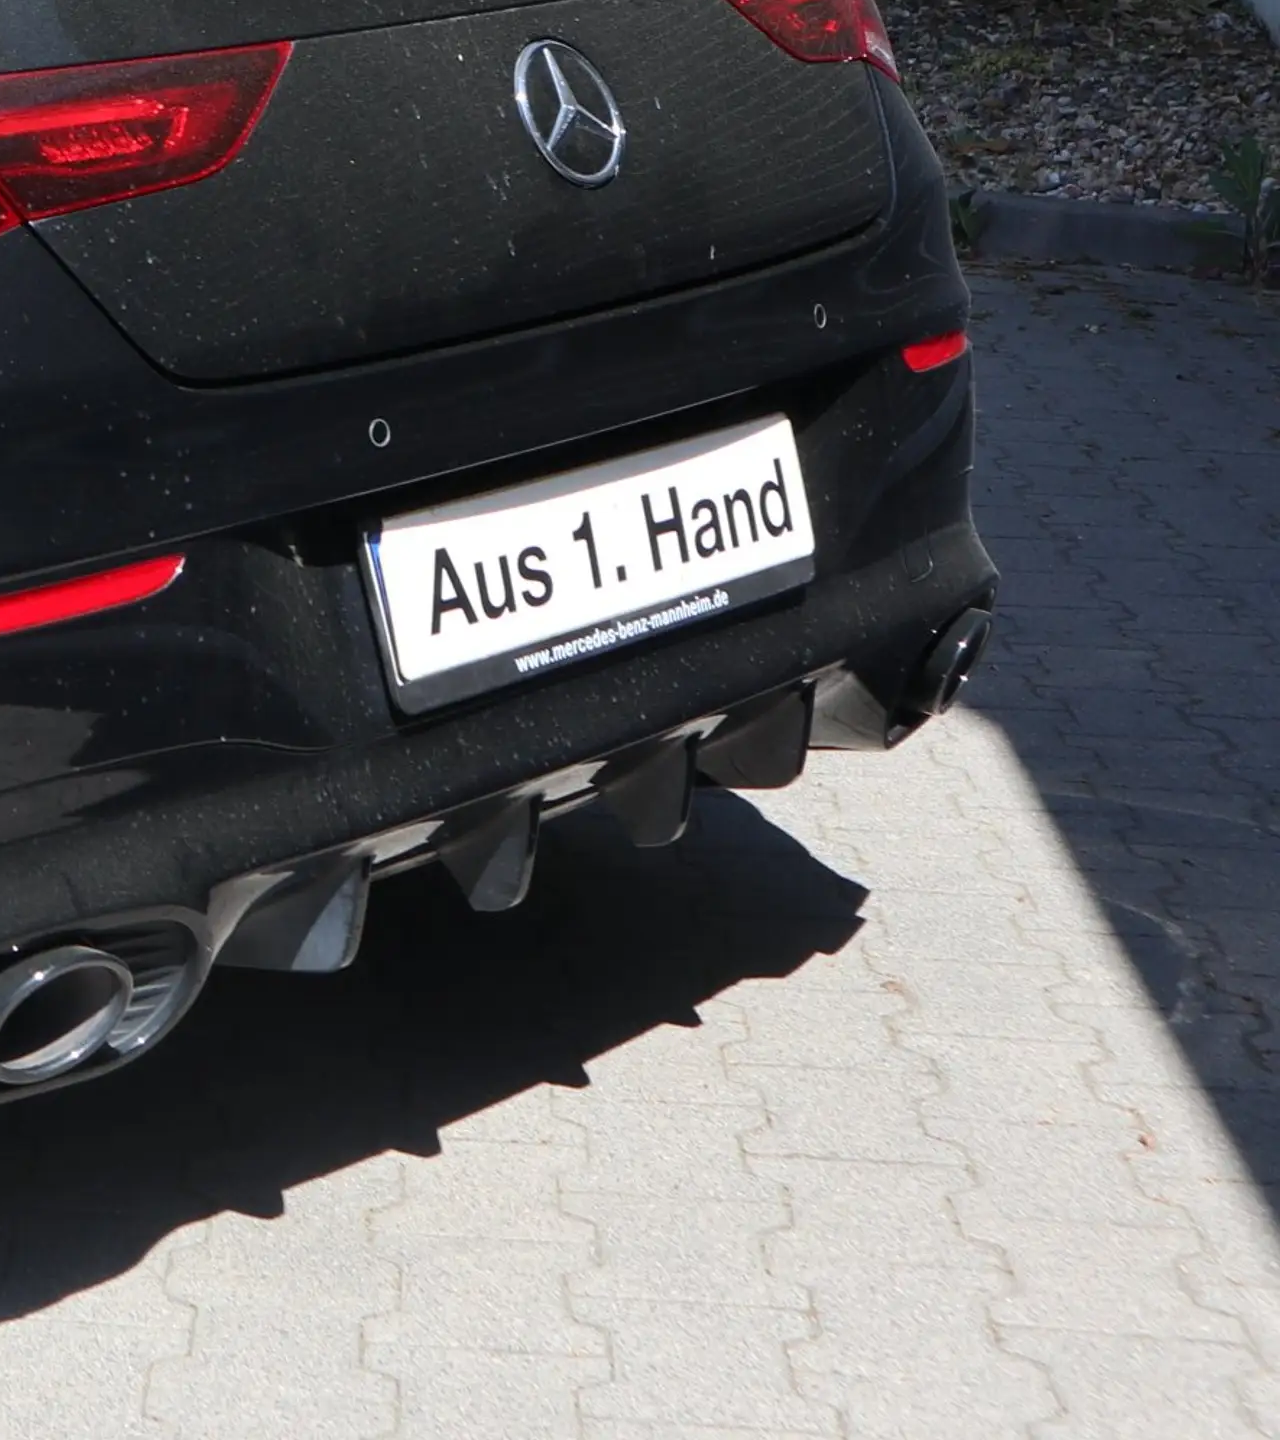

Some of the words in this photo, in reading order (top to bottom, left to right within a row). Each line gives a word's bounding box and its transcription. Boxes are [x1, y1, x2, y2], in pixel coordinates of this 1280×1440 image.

[430, 544, 554, 636] Aus
[572, 511, 628, 590] 1.
[641, 458, 794, 572] Hand
[515, 589, 730, 672] www.mercedes-benz-mannheim.de
